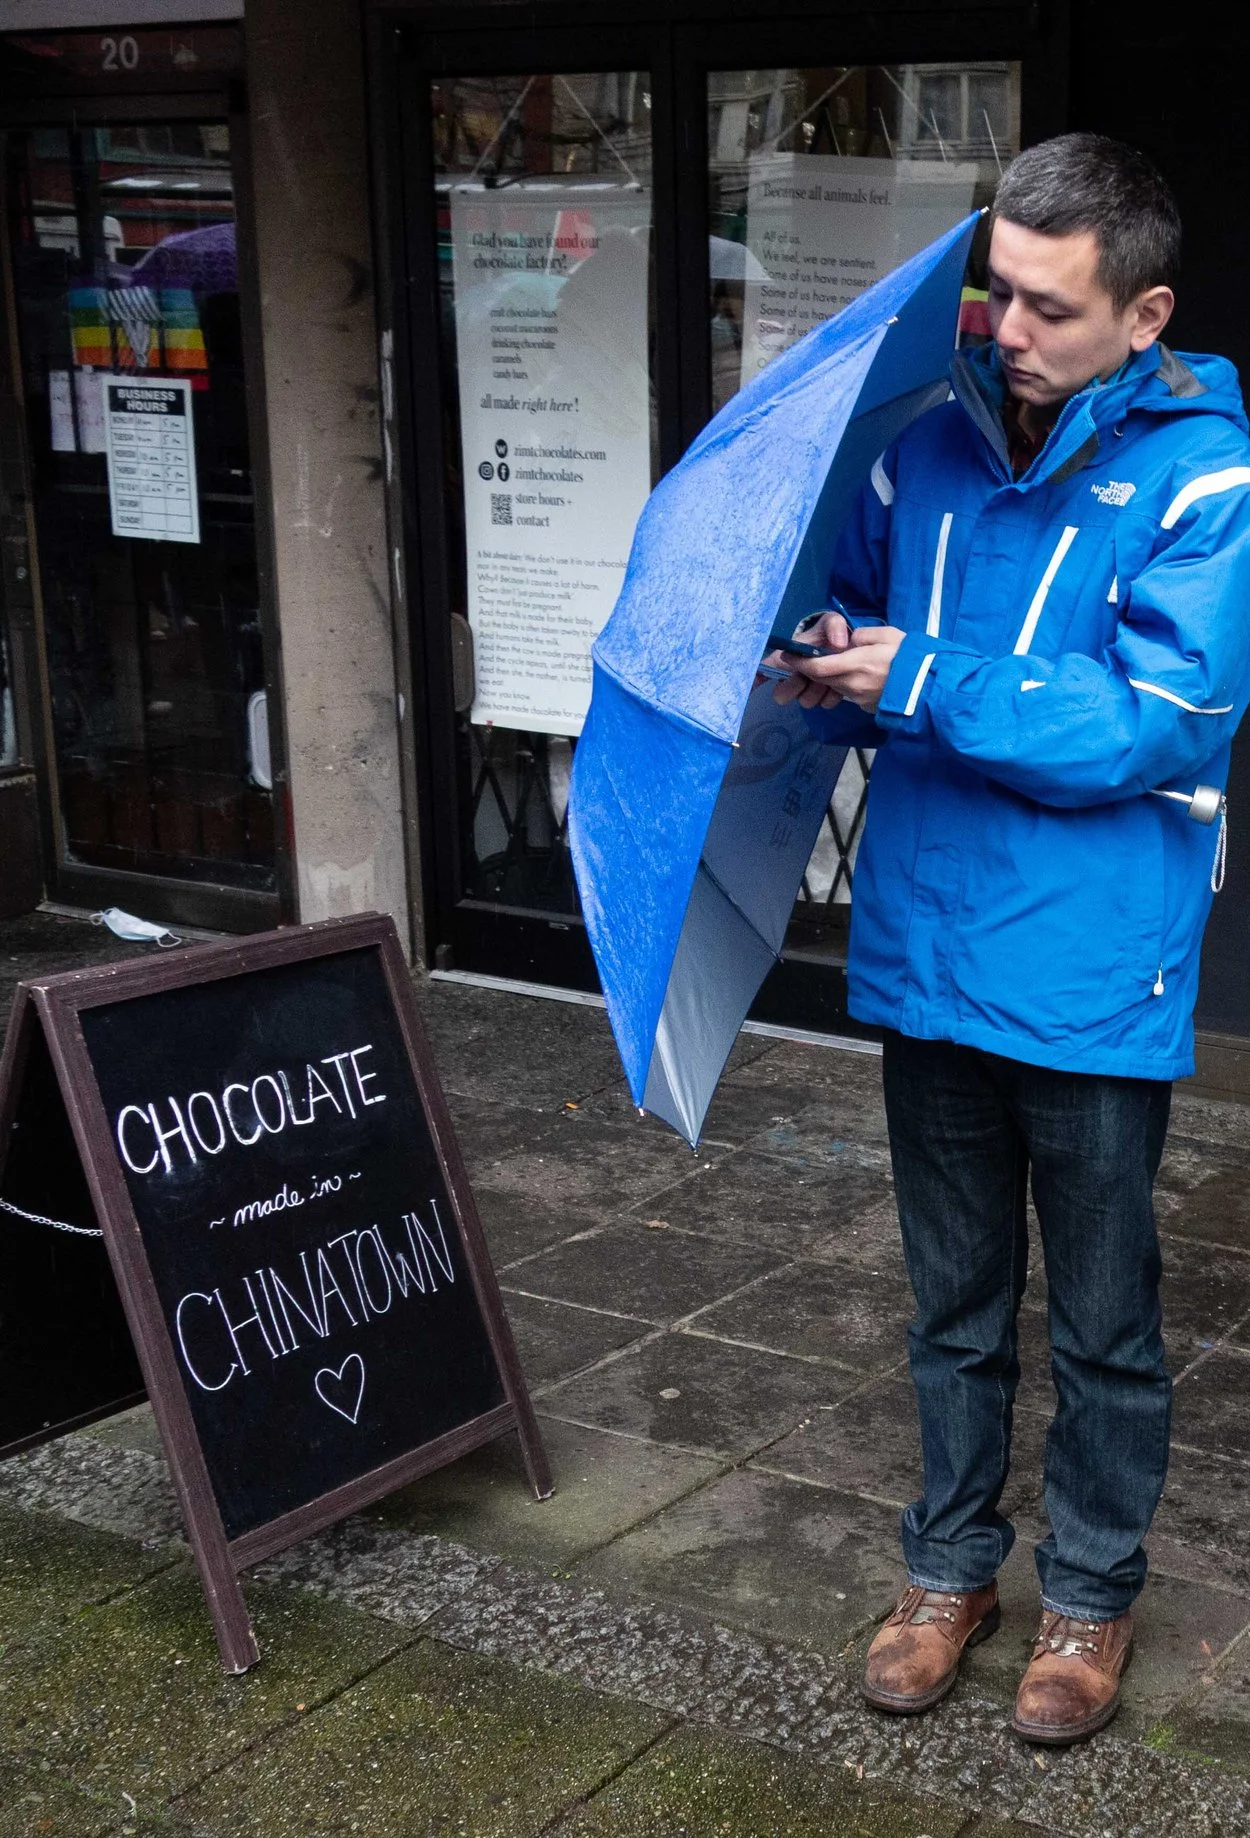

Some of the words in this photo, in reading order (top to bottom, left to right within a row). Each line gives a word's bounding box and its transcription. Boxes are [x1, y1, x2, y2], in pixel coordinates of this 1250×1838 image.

[101, 36, 139, 70] 20
[824, 188, 867, 204] animals
[813, 290, 837, 304] have
[117, 388, 176, 401] BUSINESS
[127, 401, 168, 412] HOURS
[480, 393, 491, 408] all
[494, 395, 520, 410] made
[522, 399, 547, 414] right
[514, 445, 607, 460] zimtchocolates.com
[515, 467, 583, 482] zimtchocolates
[1091, 484, 1122, 498] NORTH
[1109, 481, 1126, 490] THE
[515, 494, 537, 504] store
[539, 493, 565, 506] hours
[1097, 494, 1122, 506] FACE
[517, 516, 549, 527] contact
[117, 1044, 386, 1174] CHOCOLATE
[233, 1183, 305, 1227] made
[310, 1175, 341, 1199] in
[176, 1199, 454, 1391] CHINATOWN
